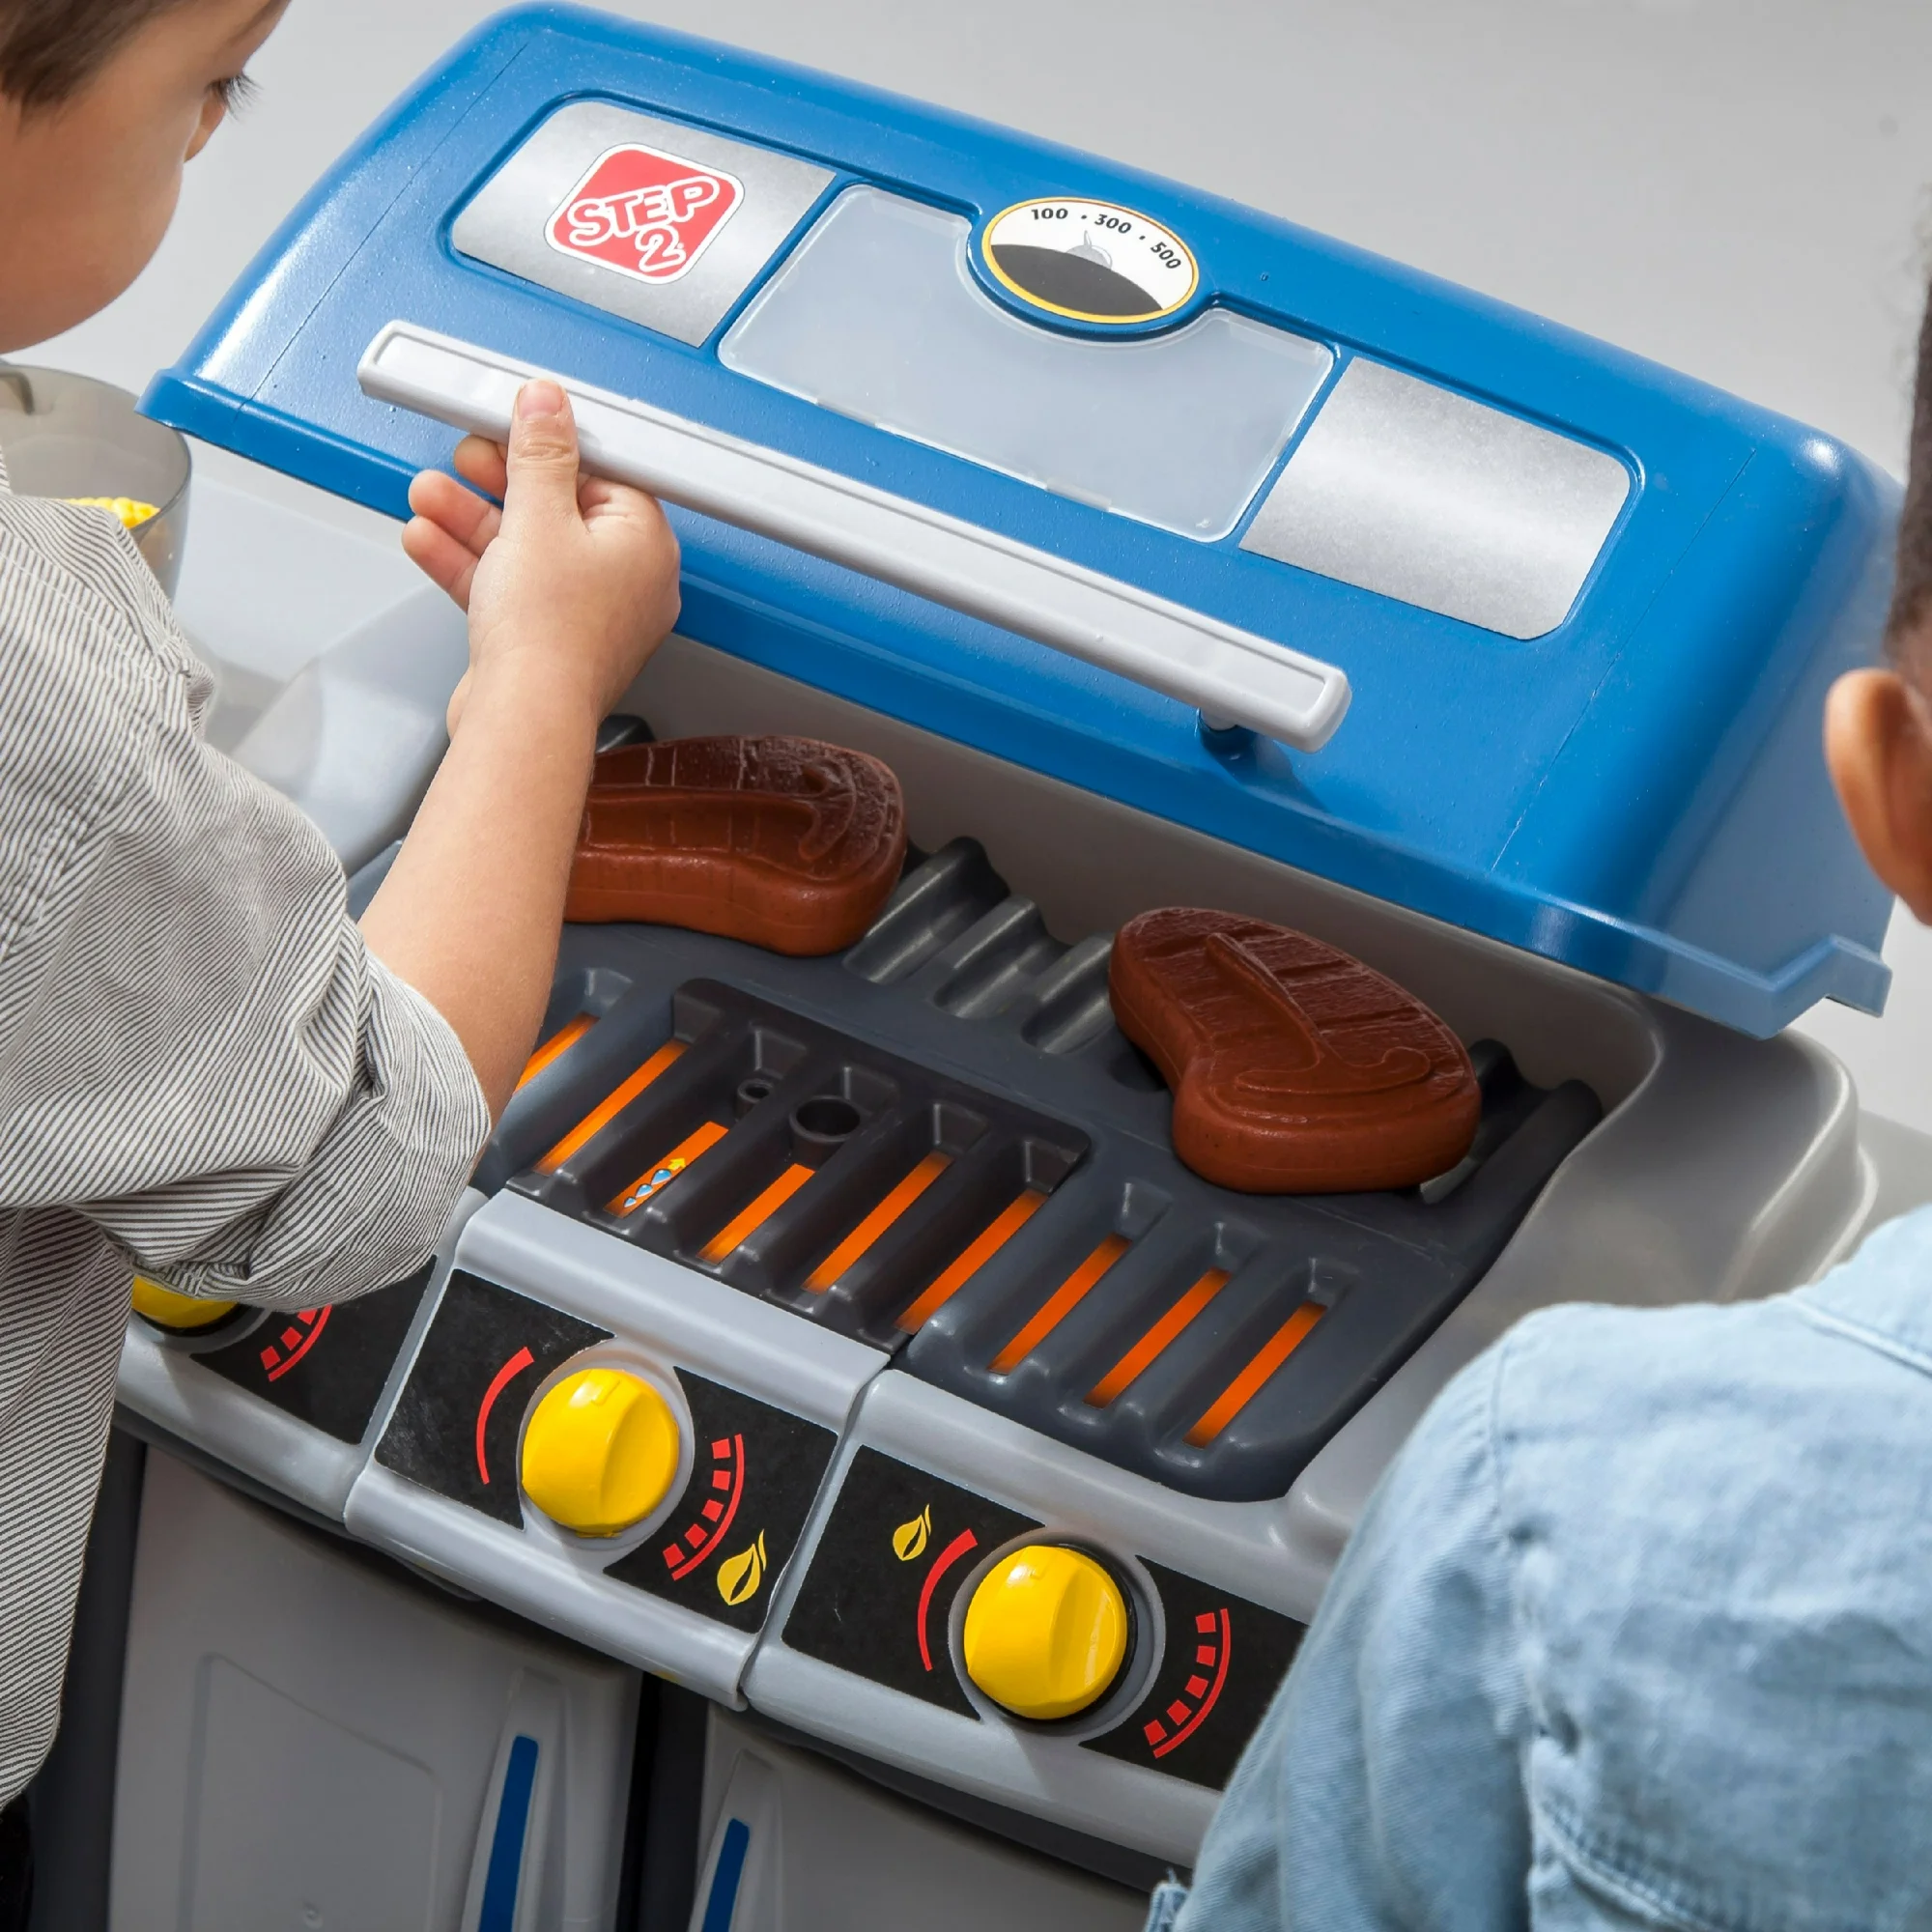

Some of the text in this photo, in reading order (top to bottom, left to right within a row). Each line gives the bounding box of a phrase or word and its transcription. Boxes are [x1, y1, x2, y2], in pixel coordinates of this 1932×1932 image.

[567, 175, 721, 247] STEP
[1031, 208, 1181, 270] 100 300 500
